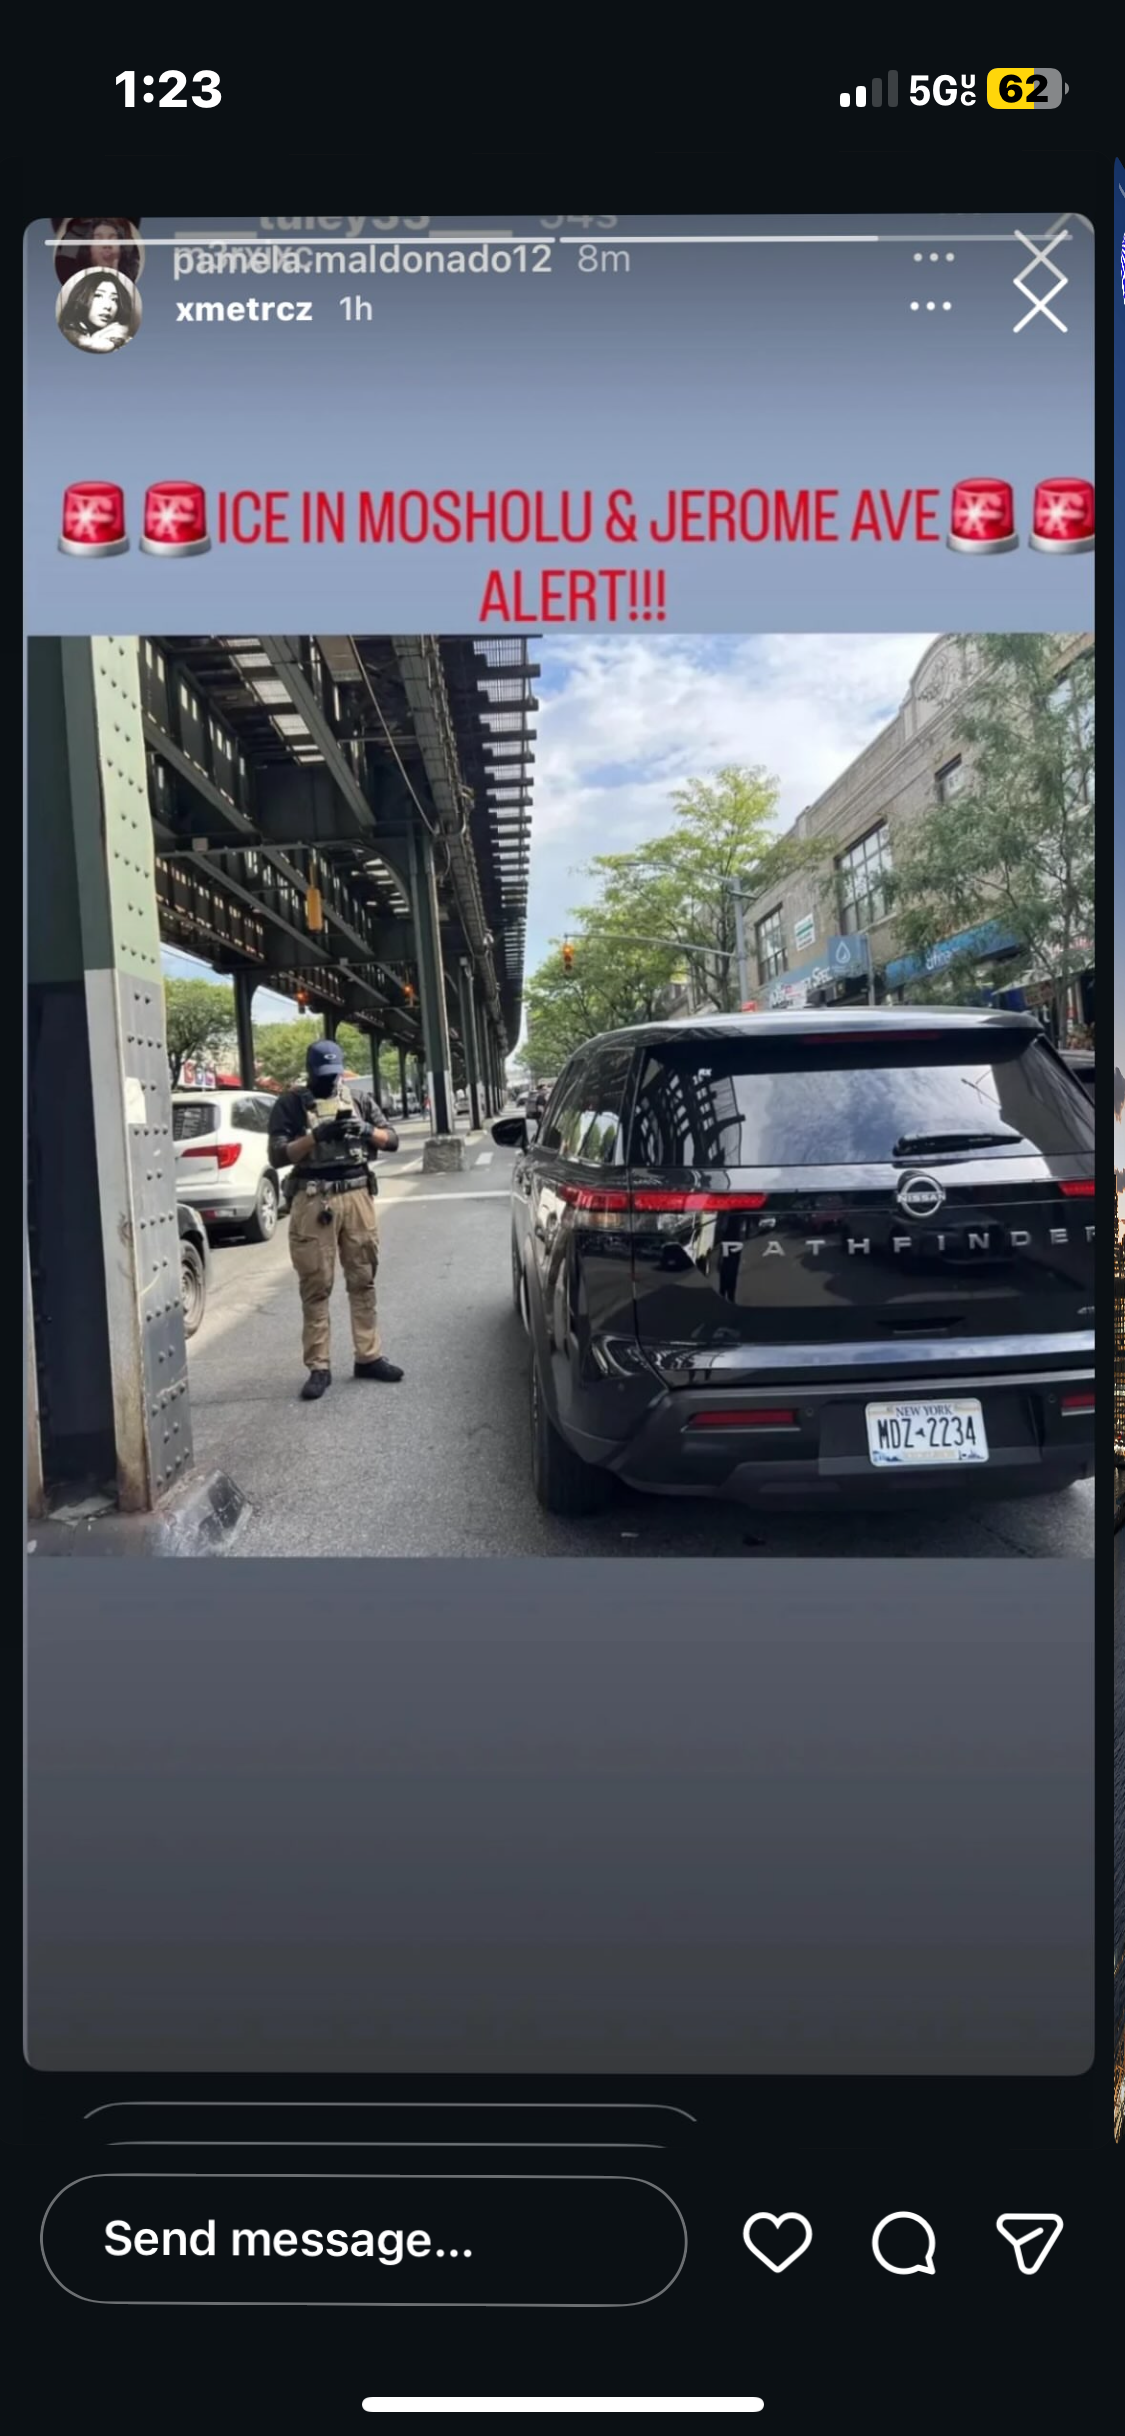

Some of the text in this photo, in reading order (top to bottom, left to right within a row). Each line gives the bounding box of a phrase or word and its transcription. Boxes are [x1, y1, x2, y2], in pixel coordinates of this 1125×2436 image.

[115, 69, 222, 109] 1:23
[998, 73, 1049, 103] 62
[174, 244, 631, 281] pamela.maldonado12 8m
[176, 295, 373, 321] xmetrcz 1h
[897, 1190, 946, 1202] NISSAN
[895, 1403, 954, 1417] NEW YORK
[104, 2219, 473, 2266] Send message...
